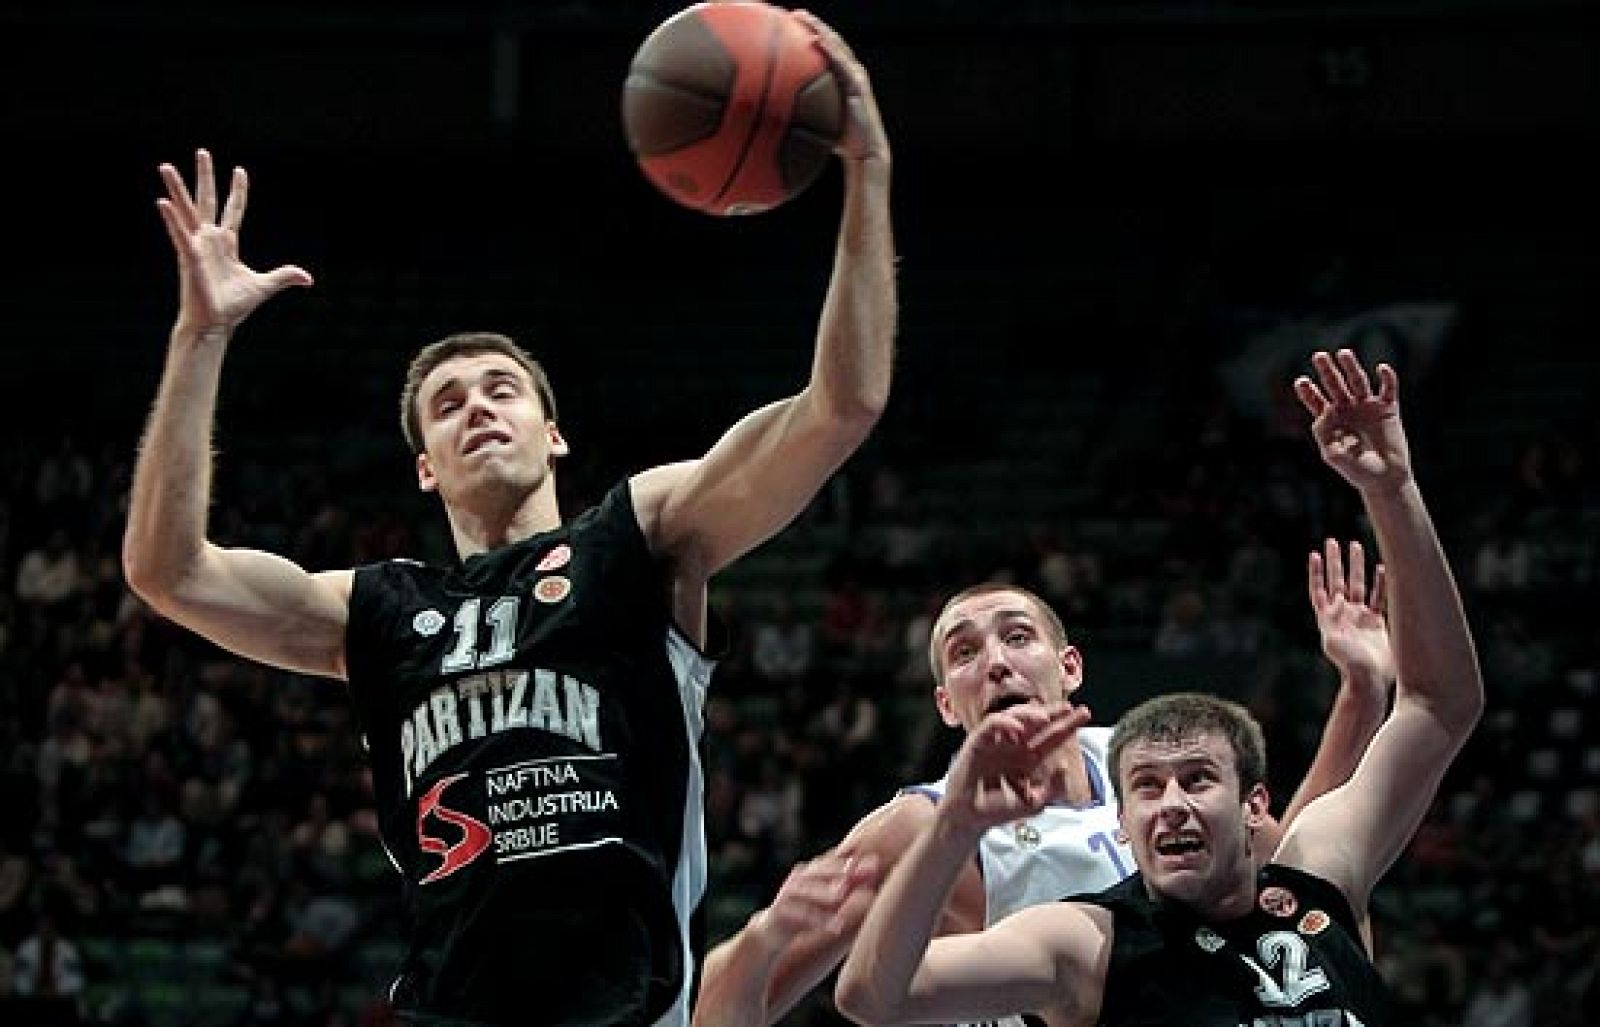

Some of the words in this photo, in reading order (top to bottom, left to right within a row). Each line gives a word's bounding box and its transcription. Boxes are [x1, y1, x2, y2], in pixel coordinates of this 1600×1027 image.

[441, 596, 520, 675] 11
[401, 669, 601, 799] PARTIZAN
[487, 762, 580, 798] NAFTNA
[487, 790, 620, 824] INDUSTRIJA
[494, 823, 560, 853] SRBIJE
